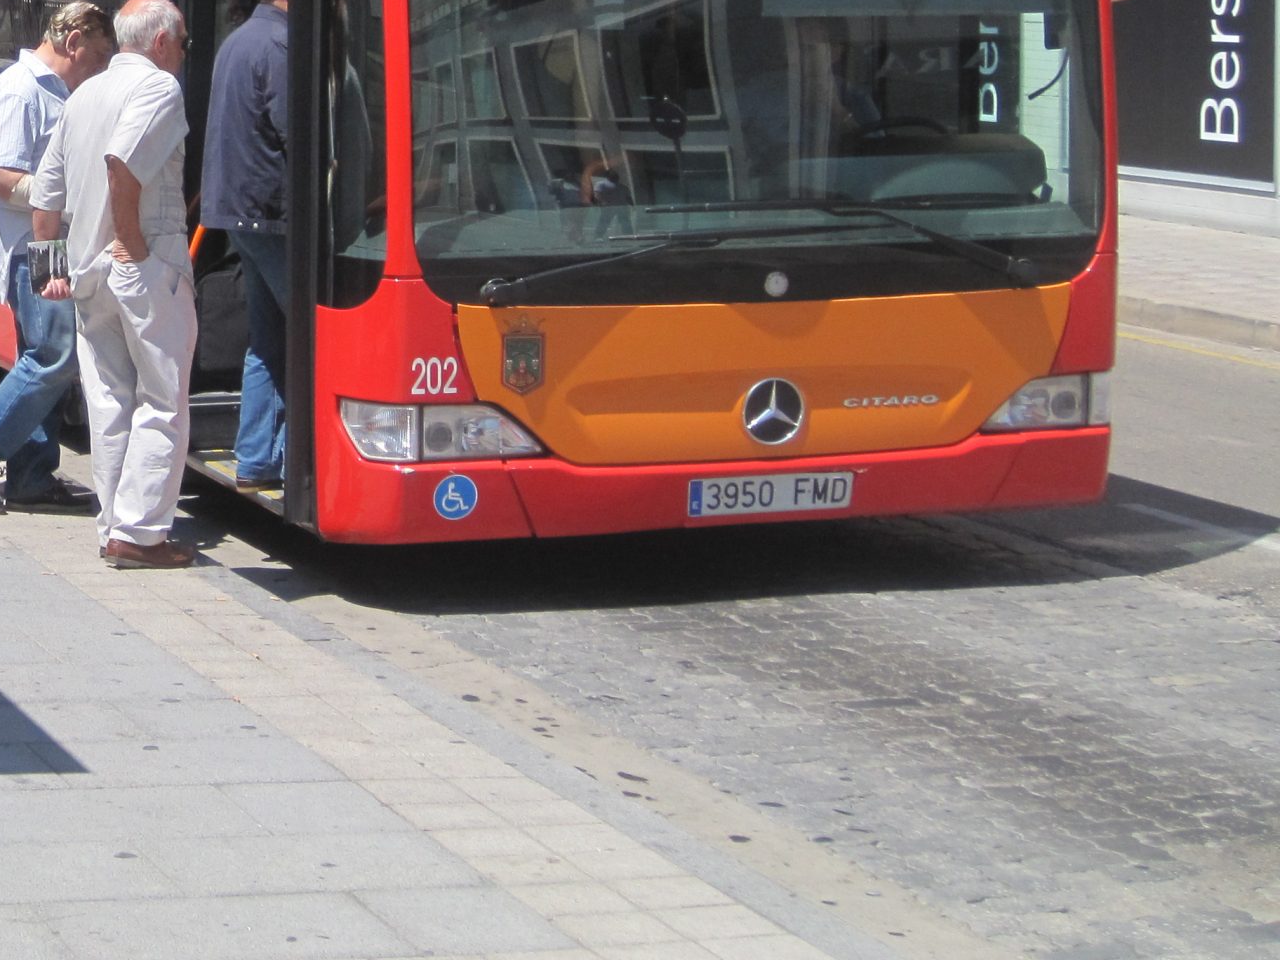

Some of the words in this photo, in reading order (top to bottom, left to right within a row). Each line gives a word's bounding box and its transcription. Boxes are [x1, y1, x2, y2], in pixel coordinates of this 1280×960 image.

[411, 357, 458, 395] 202
[843, 395, 939, 408] CITARO
[706, 481, 774, 510] 3950
[793, 477, 848, 506] FMD
